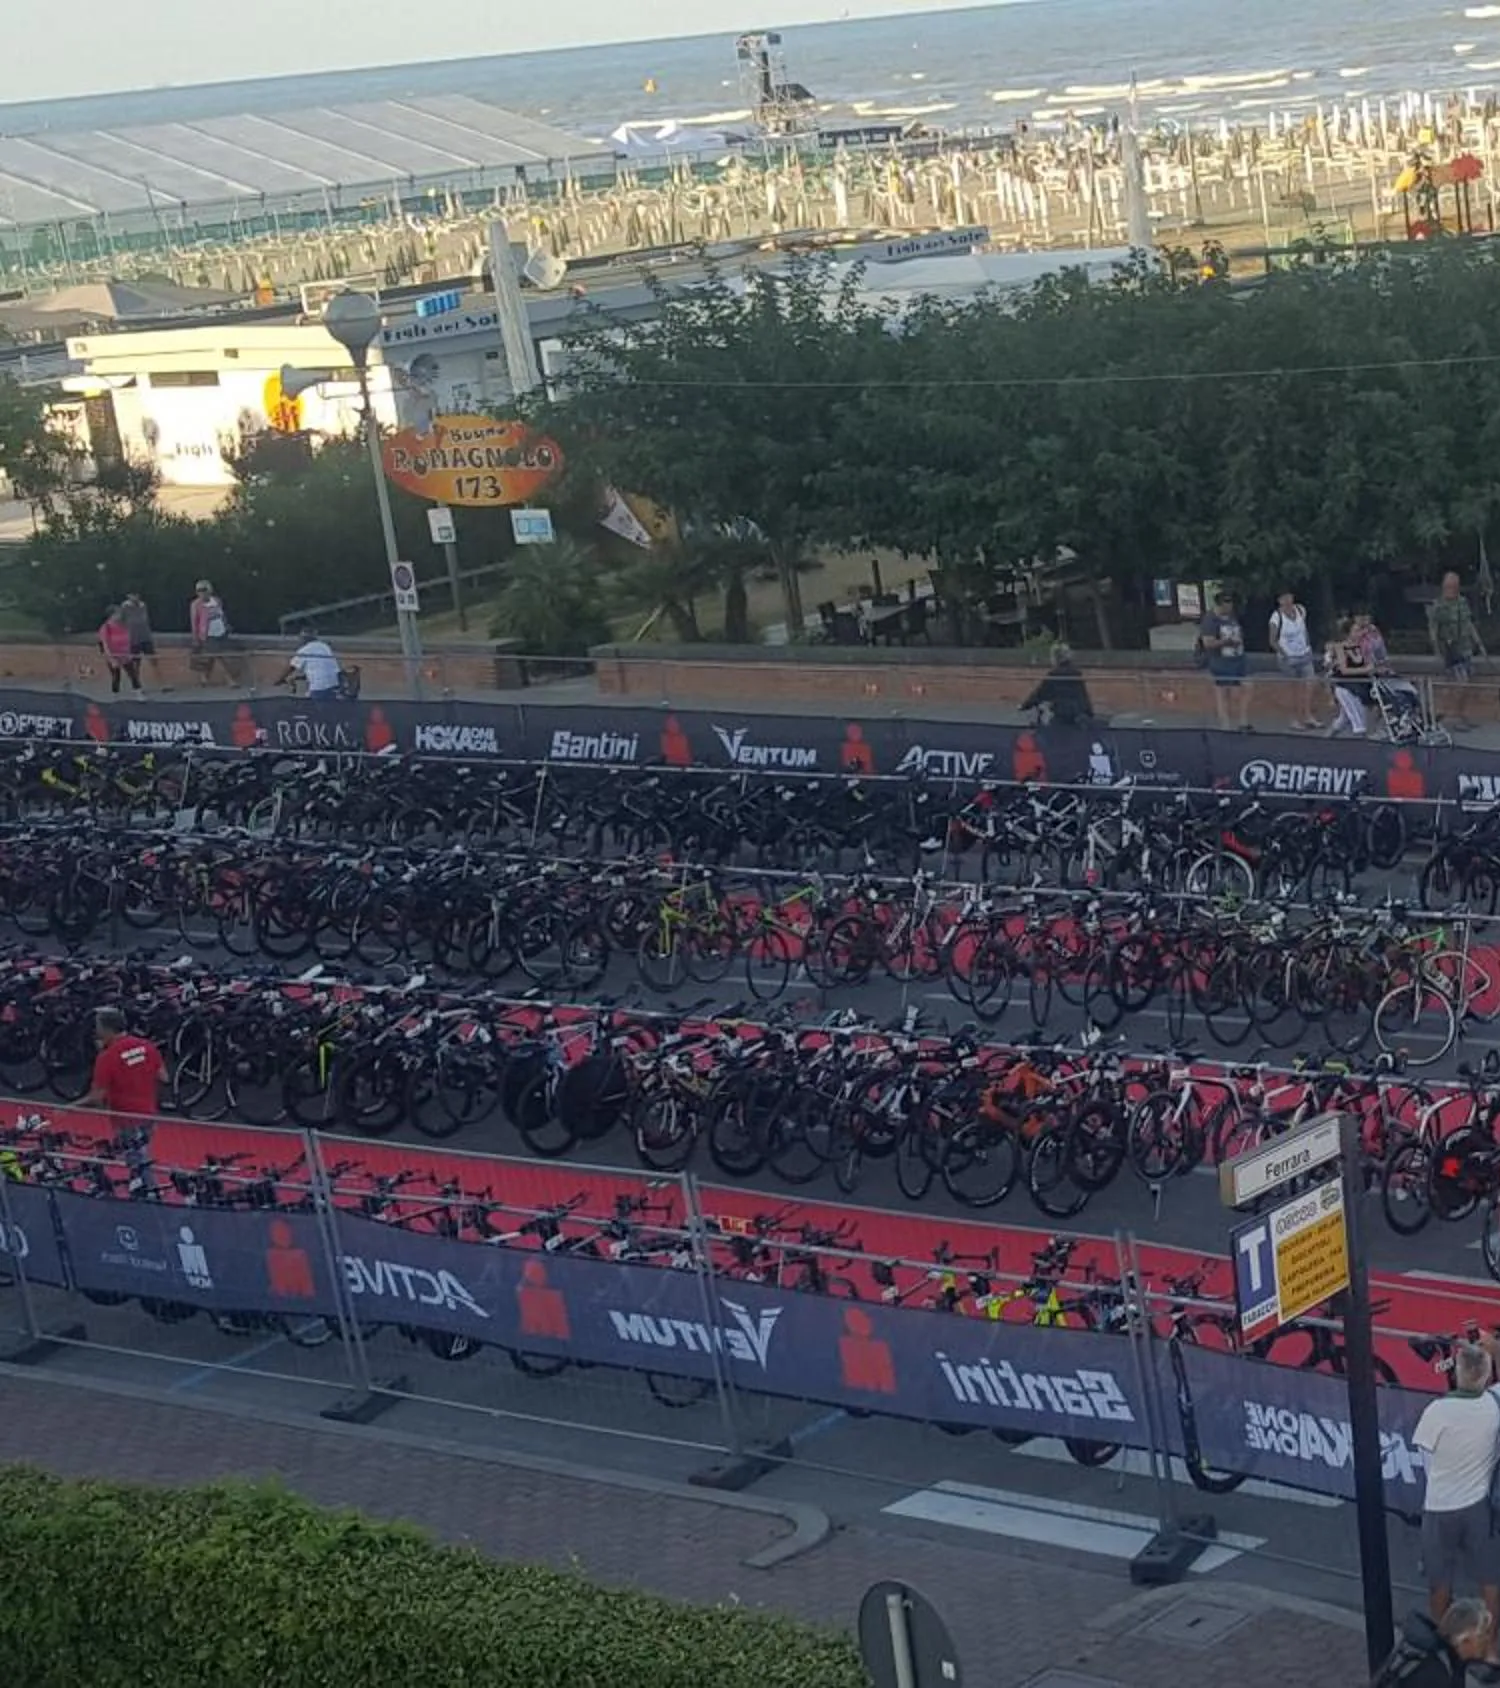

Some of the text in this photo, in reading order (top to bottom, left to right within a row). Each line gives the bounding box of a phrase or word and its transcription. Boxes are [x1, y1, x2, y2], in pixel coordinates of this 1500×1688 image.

[455, 475, 501, 499] 173
[551, 730, 639, 760] Santini
[711, 724, 817, 766] VENTUM
[896, 745, 995, 777] ACTIVE
[1264, 1148, 1312, 1181] Ferrara
[1239, 1225, 1268, 1292] T
